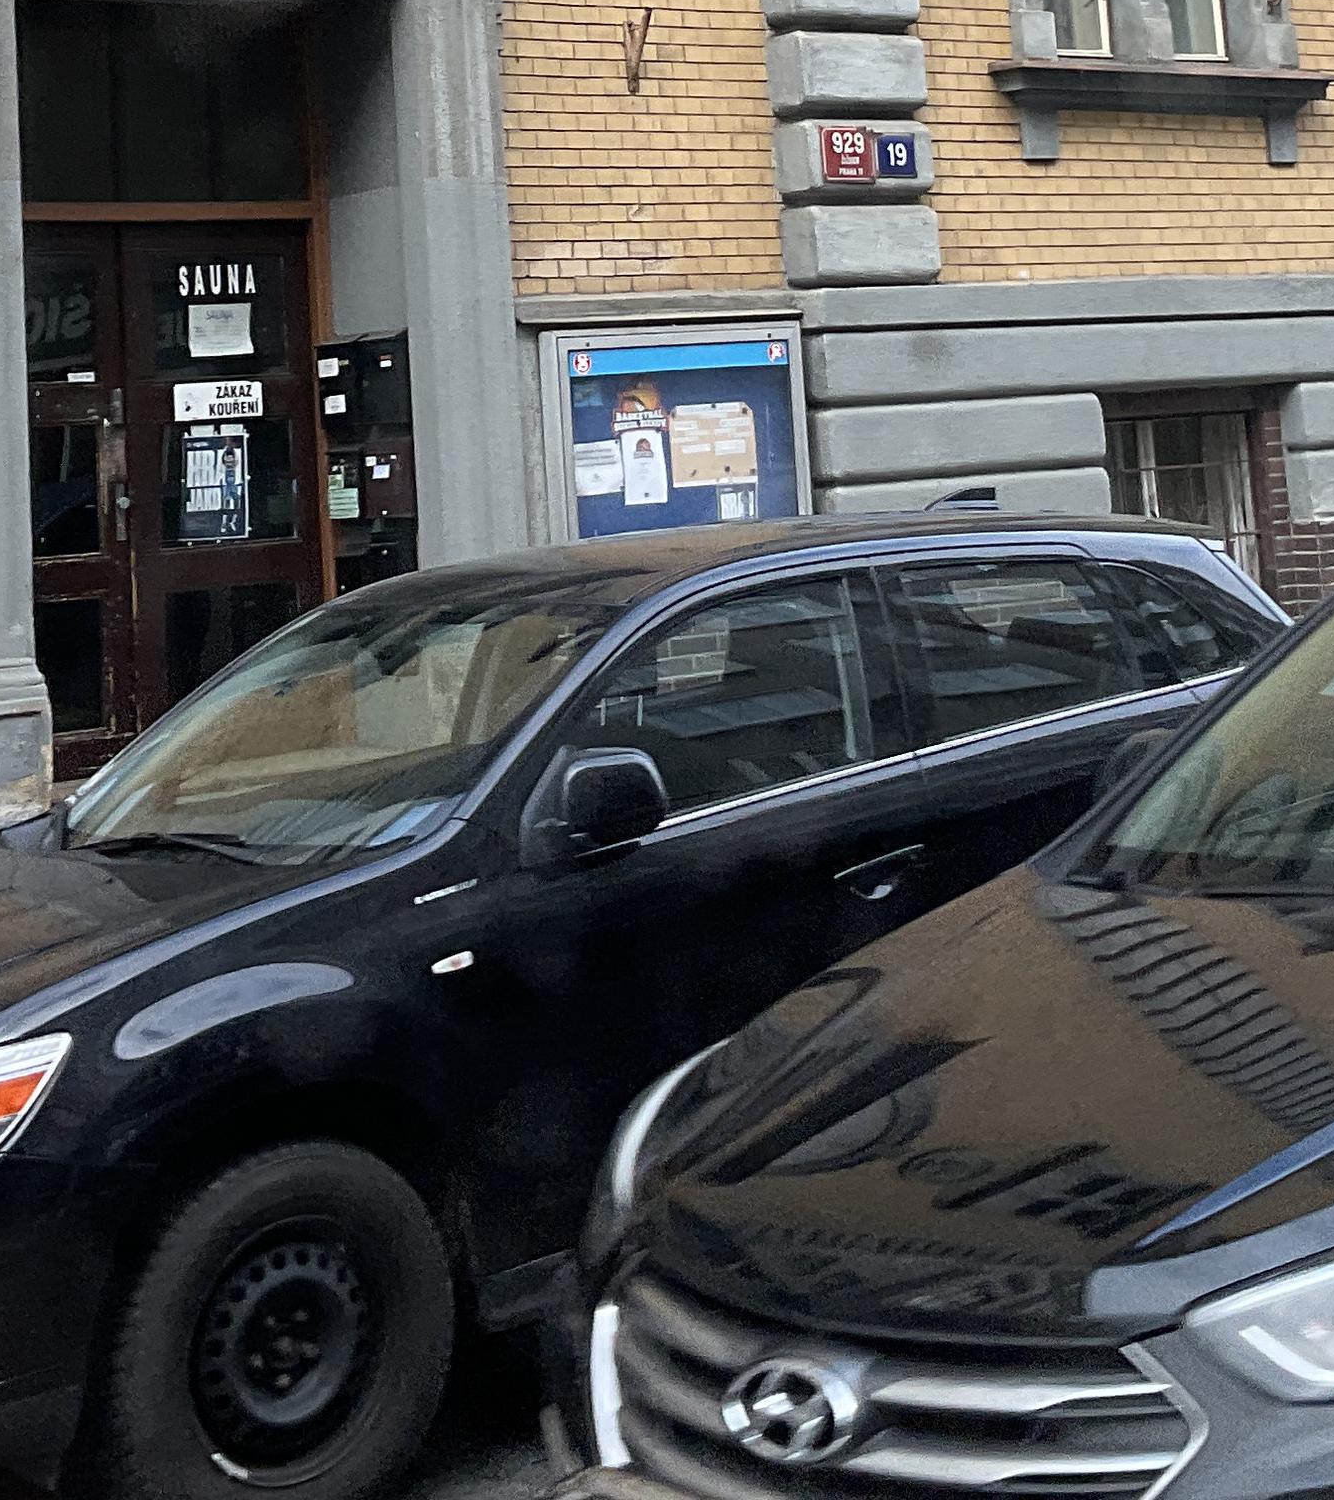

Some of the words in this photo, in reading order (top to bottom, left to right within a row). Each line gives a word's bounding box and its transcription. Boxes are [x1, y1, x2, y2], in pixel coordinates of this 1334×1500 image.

[831, 131, 865, 155] 929
[886, 142, 908, 167] 19
[178, 263, 257, 297] SAUNA
[215, 383, 253, 399] ZÁKAZ
[208, 397, 260, 417] KOUŘENÍ
